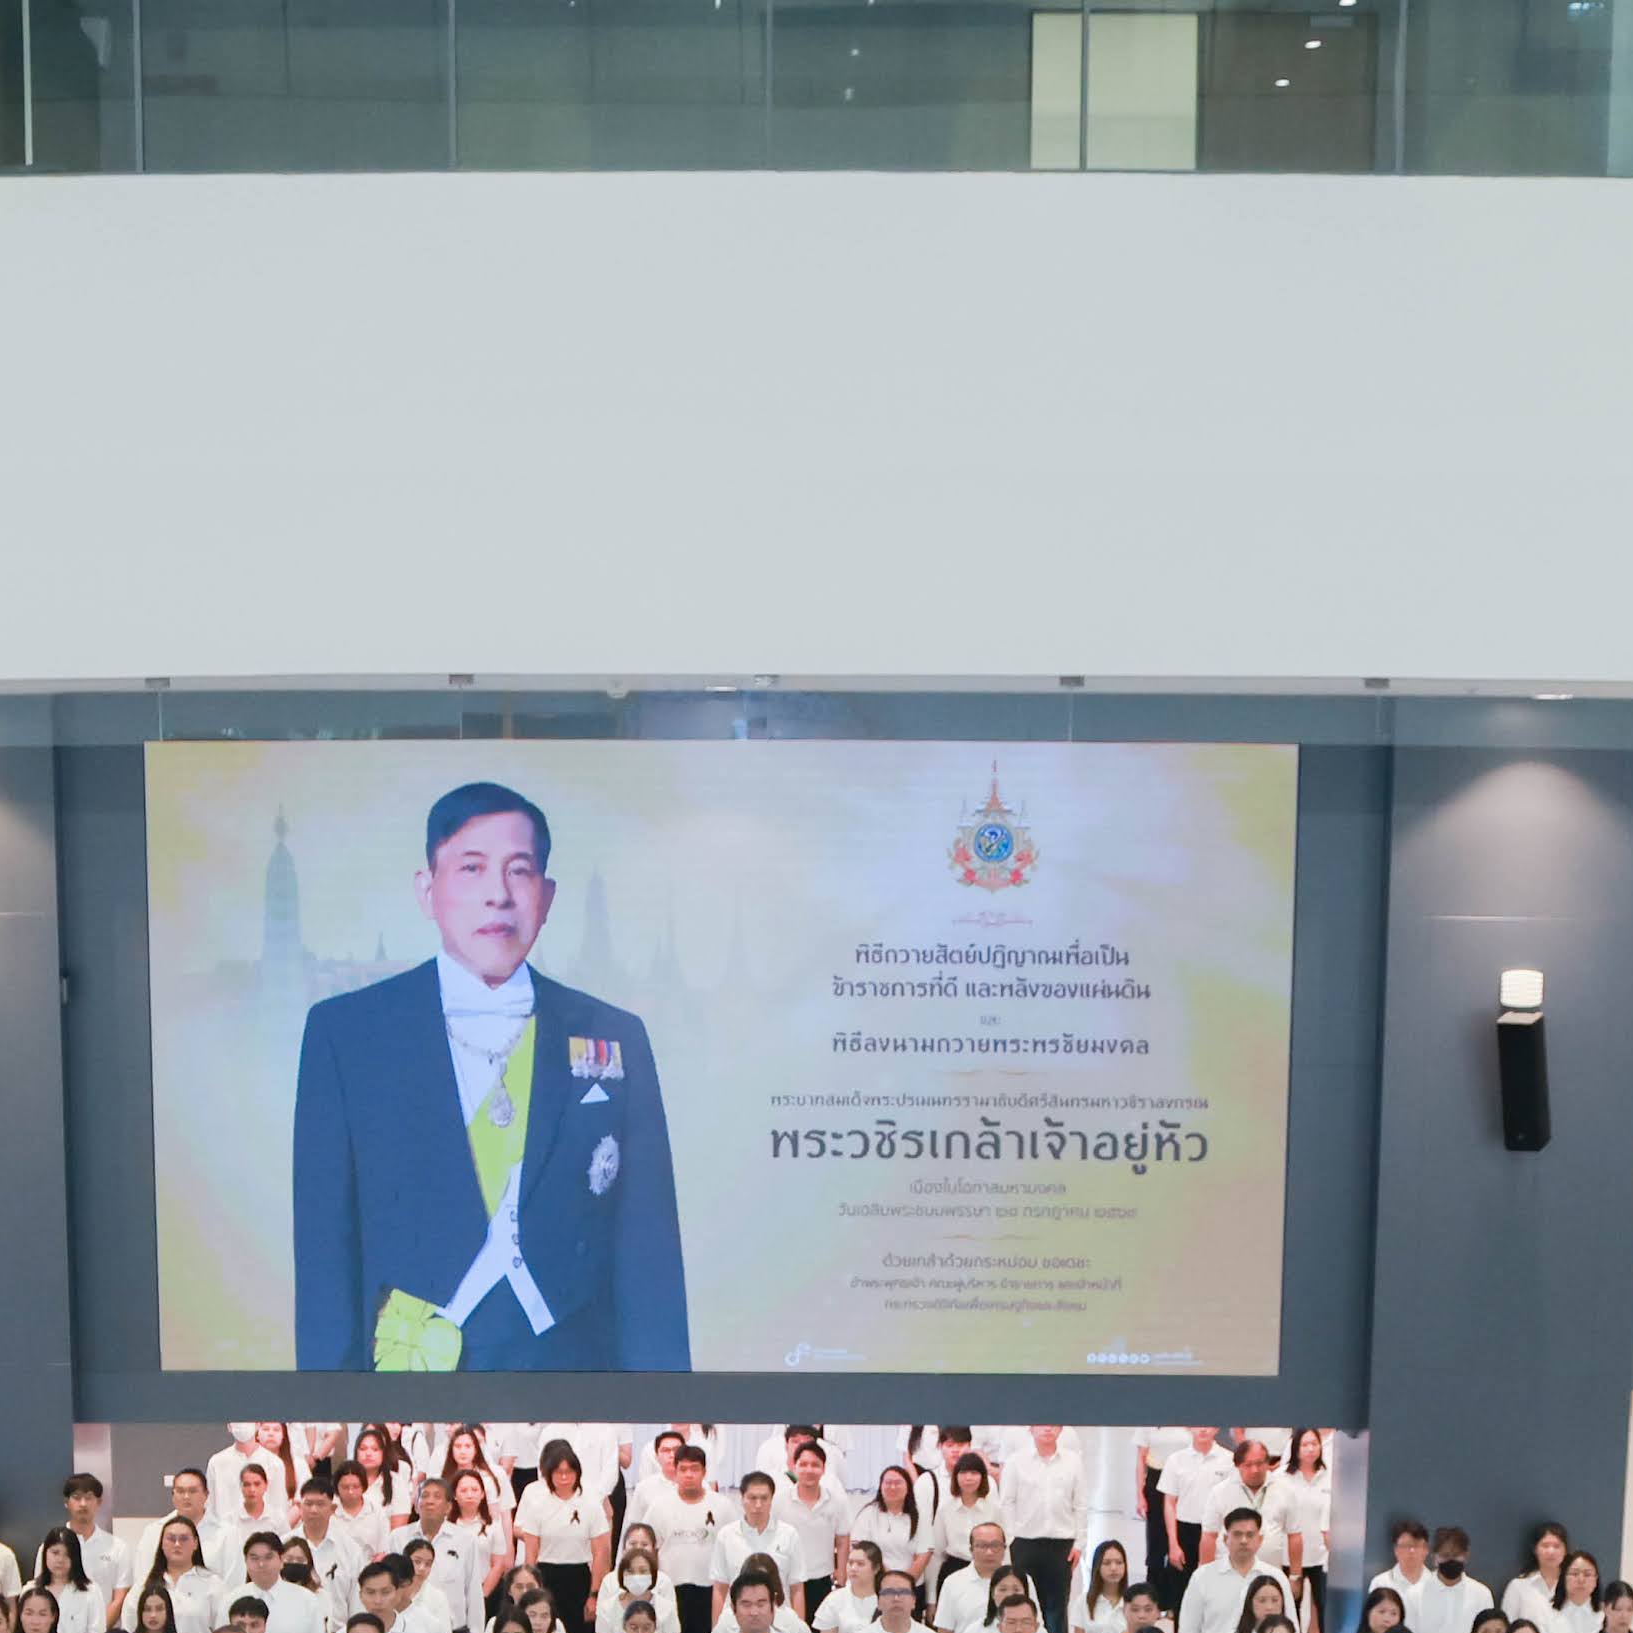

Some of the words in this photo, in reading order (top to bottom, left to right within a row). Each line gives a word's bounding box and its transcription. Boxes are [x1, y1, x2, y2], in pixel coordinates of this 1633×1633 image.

[855, 940, 1131, 969] พิธีถวายสัตย์ปฏิญาณเพื่อเป็น
[832, 971, 959, 998] ข้าราชการที่ดี
[965, 975, 1152, 1000] และพลังของแผ่นดิน
[831, 1032, 1150, 1056] พิธีลงนามถวายพระพรชัยมงคล
[770, 1115, 1209, 1175] พระวชิรเกล้าเจ้าอยู่หัว
